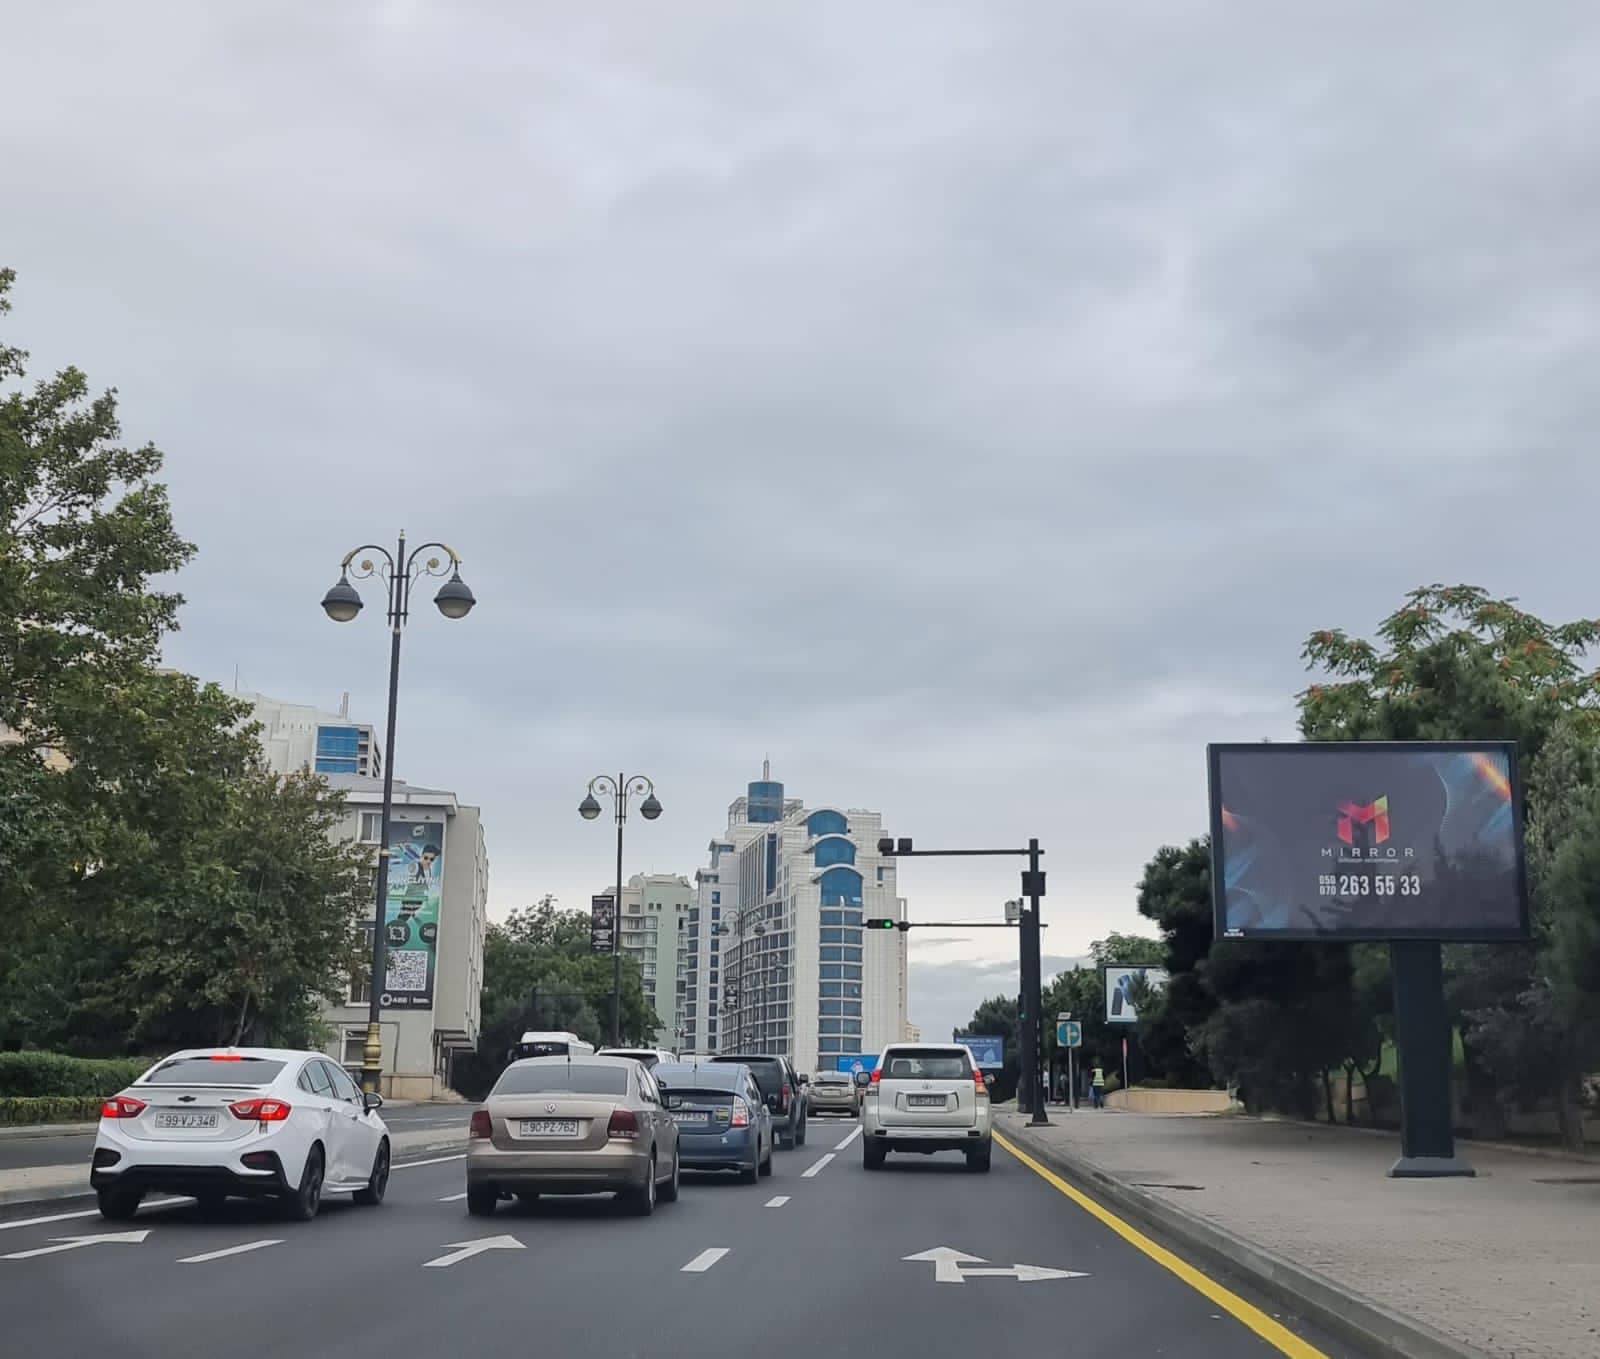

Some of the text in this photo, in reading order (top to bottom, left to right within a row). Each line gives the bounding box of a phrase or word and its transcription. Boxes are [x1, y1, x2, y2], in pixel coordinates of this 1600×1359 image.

[1320, 847, 1414, 857] MIRROR
[1319, 885, 1337, 896] 070
[1340, 875, 1421, 896] 263 55 33
